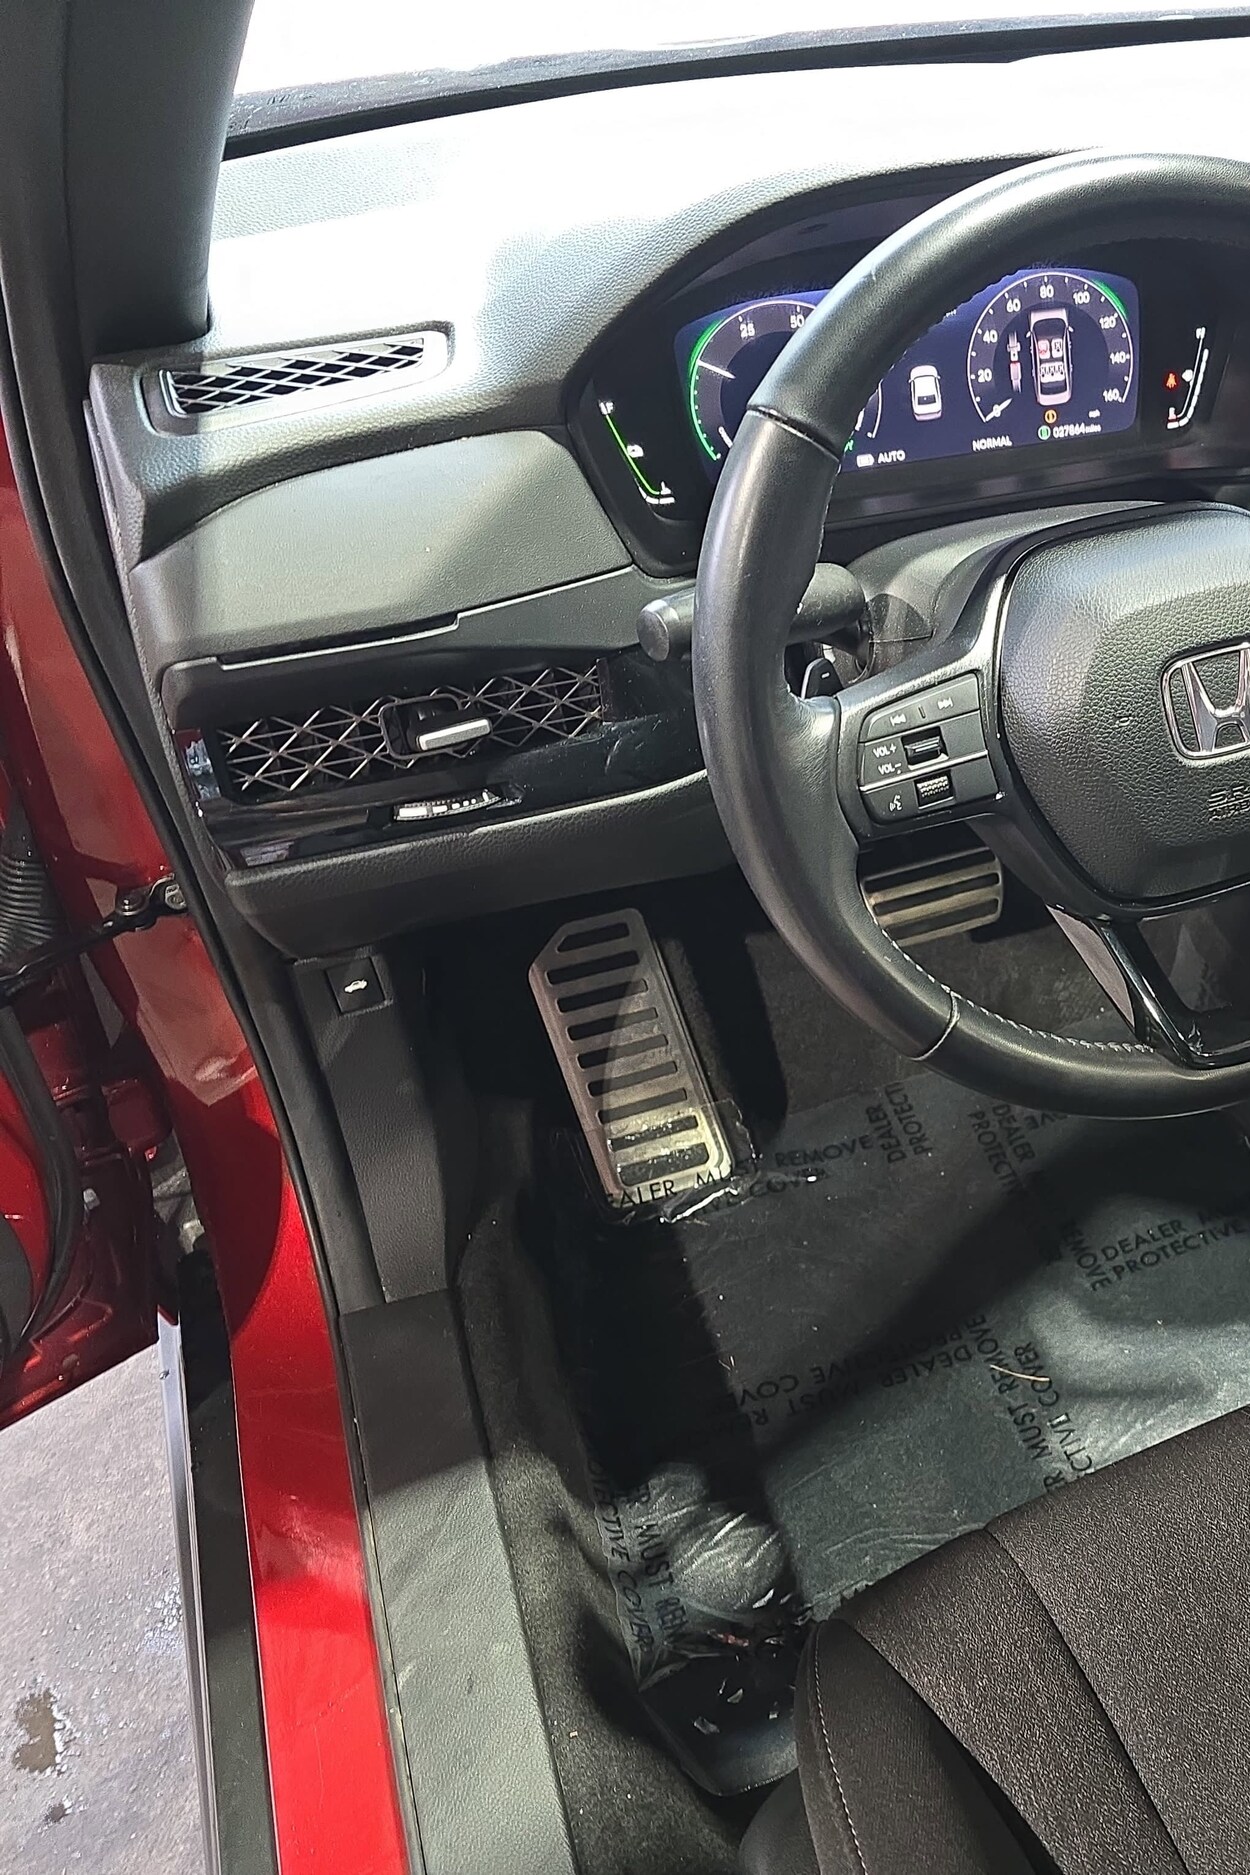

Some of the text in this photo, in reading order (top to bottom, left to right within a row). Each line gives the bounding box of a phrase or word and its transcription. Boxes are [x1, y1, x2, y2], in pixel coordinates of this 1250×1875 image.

[1040, 285, 1054, 298] 80
[1073, 292, 1090, 304] 100
[1006, 299, 1021, 312] 60
[740, 323, 755, 338] 25
[790, 314, 805, 329] 50
[1099, 316, 1116, 329] 120
[983, 329, 998, 343] 40
[1110, 353, 1126, 364] 140
[978, 369, 992, 383] 20
[1103, 389, 1119, 402] 160
[972, 435, 1012, 451] NORMAL
[877, 450, 905, 464] AUTO
[884, 1082, 933, 1156] PROTECTI
[866, 1102, 908, 1164] DEALER
[992, 1103, 1036, 1163] DEALER
[775, 1134, 874, 1168] REMOVE
[1102, 1219, 1187, 1262] DEALER
[1113, 1218, 1248, 1281] PROTECTIVE
[877, 1347, 972, 1388] DEALER
[1014, 1341, 1060, 1407] COVER
[965, 1315, 1053, 1460] MUST REMOVE
[1048, 1412, 1093, 1474] CTIVE
[635, 1523, 674, 1586] MUST
[617, 1570, 655, 1647] COVER
